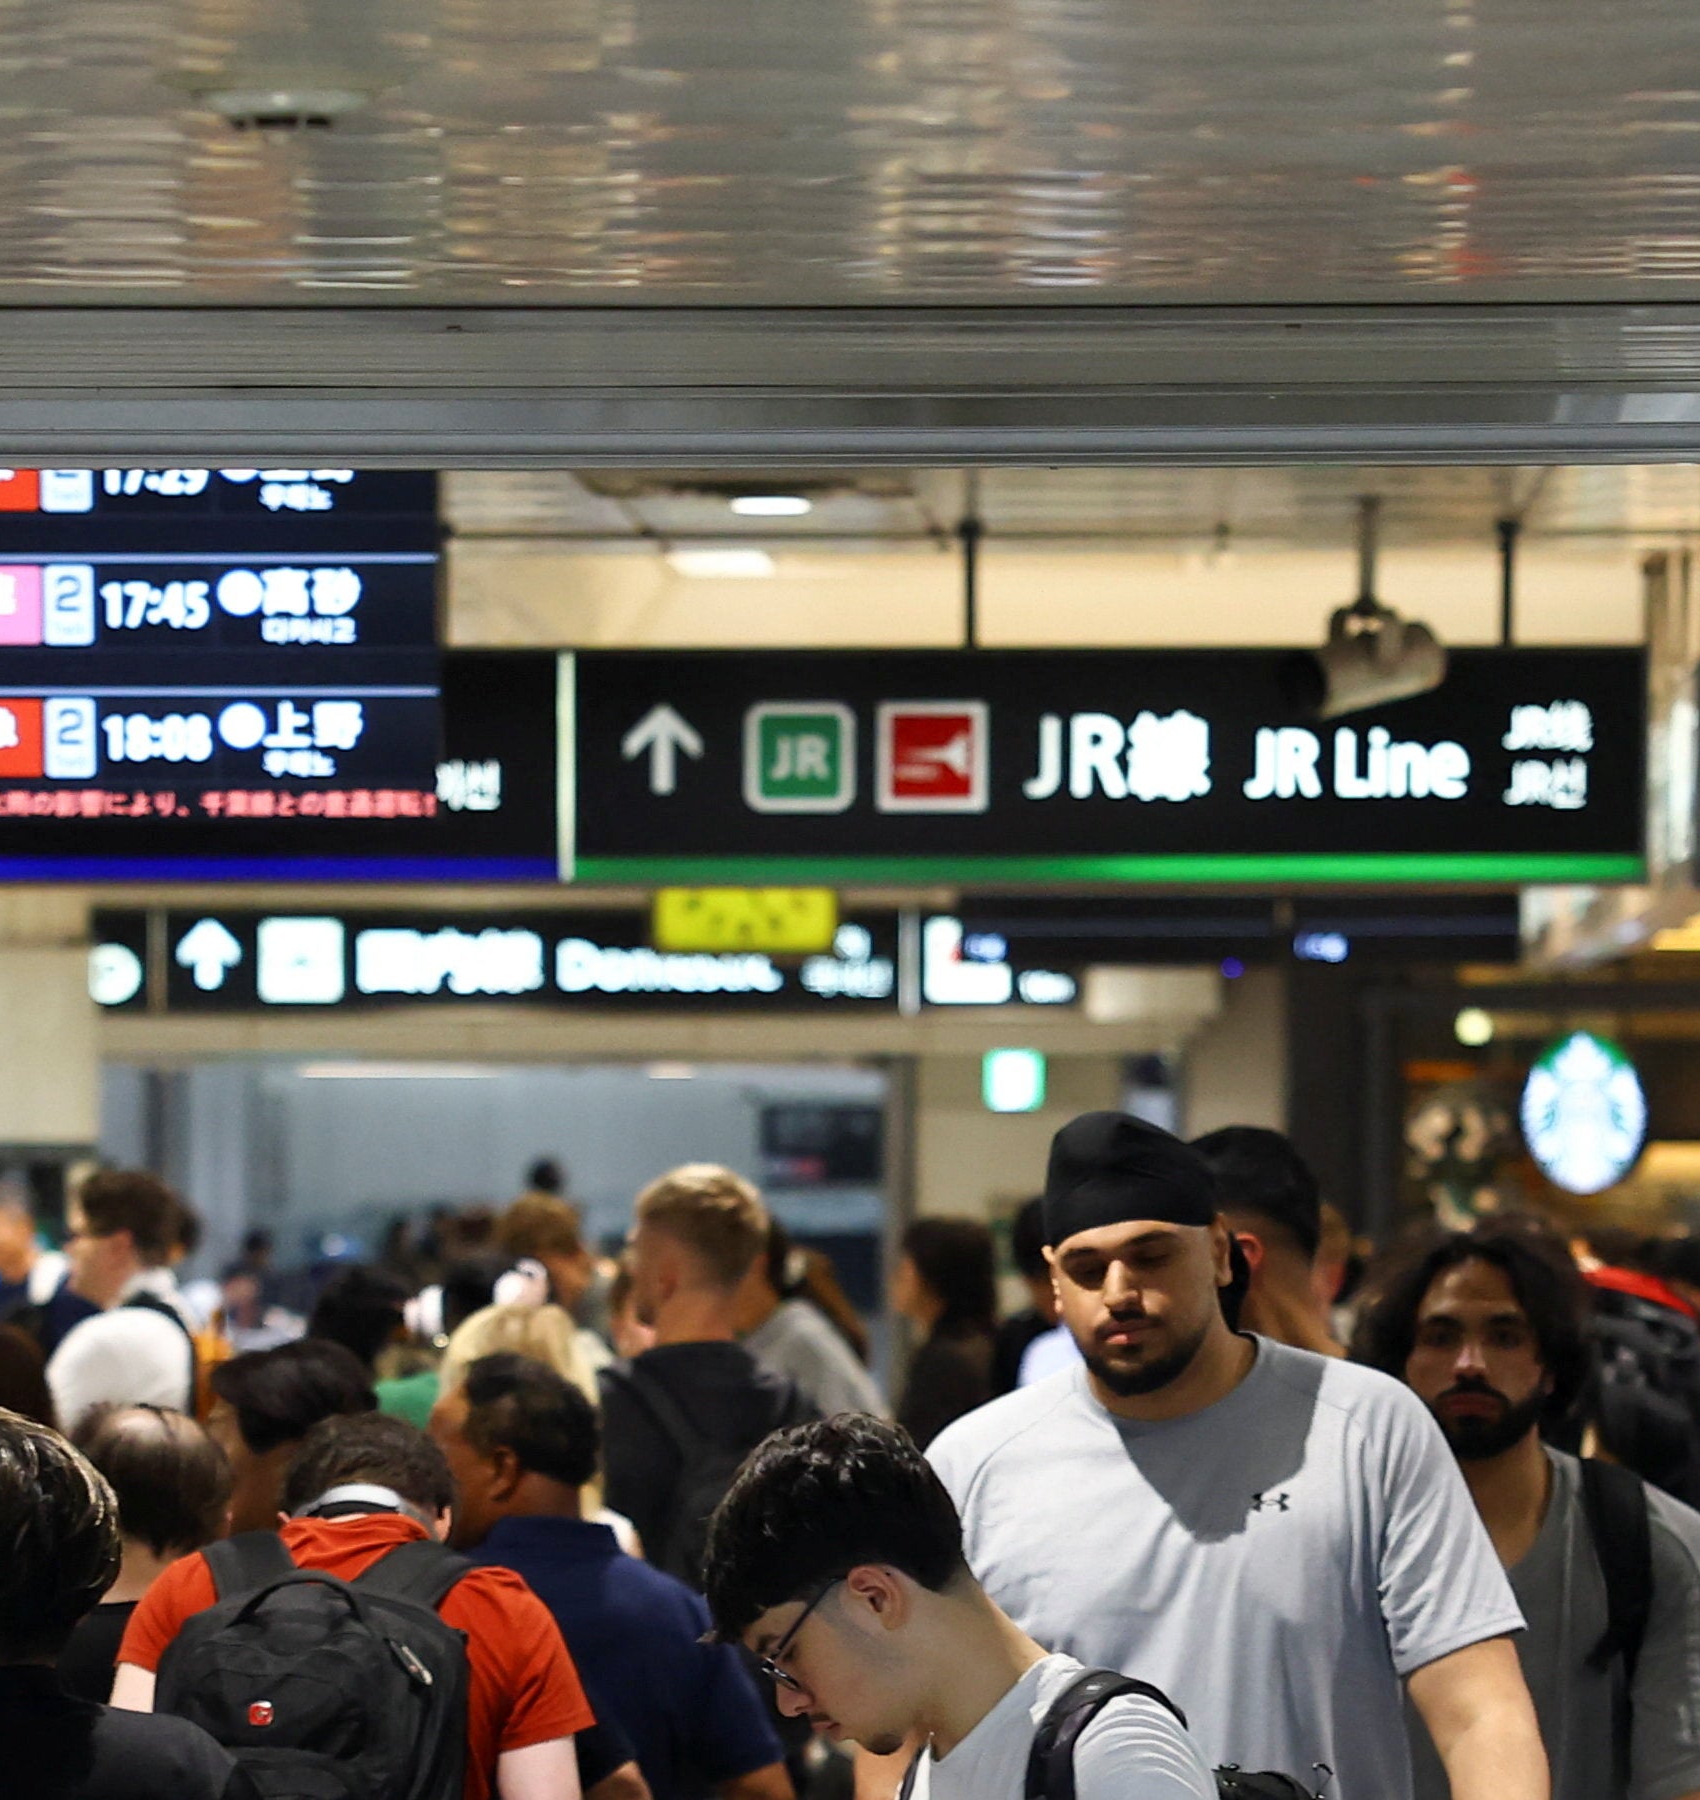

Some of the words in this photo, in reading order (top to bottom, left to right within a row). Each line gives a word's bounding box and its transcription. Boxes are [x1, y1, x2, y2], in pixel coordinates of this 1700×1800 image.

[55, 574, 81, 612] 2
[100, 582, 210, 629] 17:45
[58, 707, 84, 745] 2
[262, 701, 363, 749] 上野
[770, 733, 832, 781] JR
[1244, 727, 1321, 800] JR
[1334, 727, 1471, 800] Line
